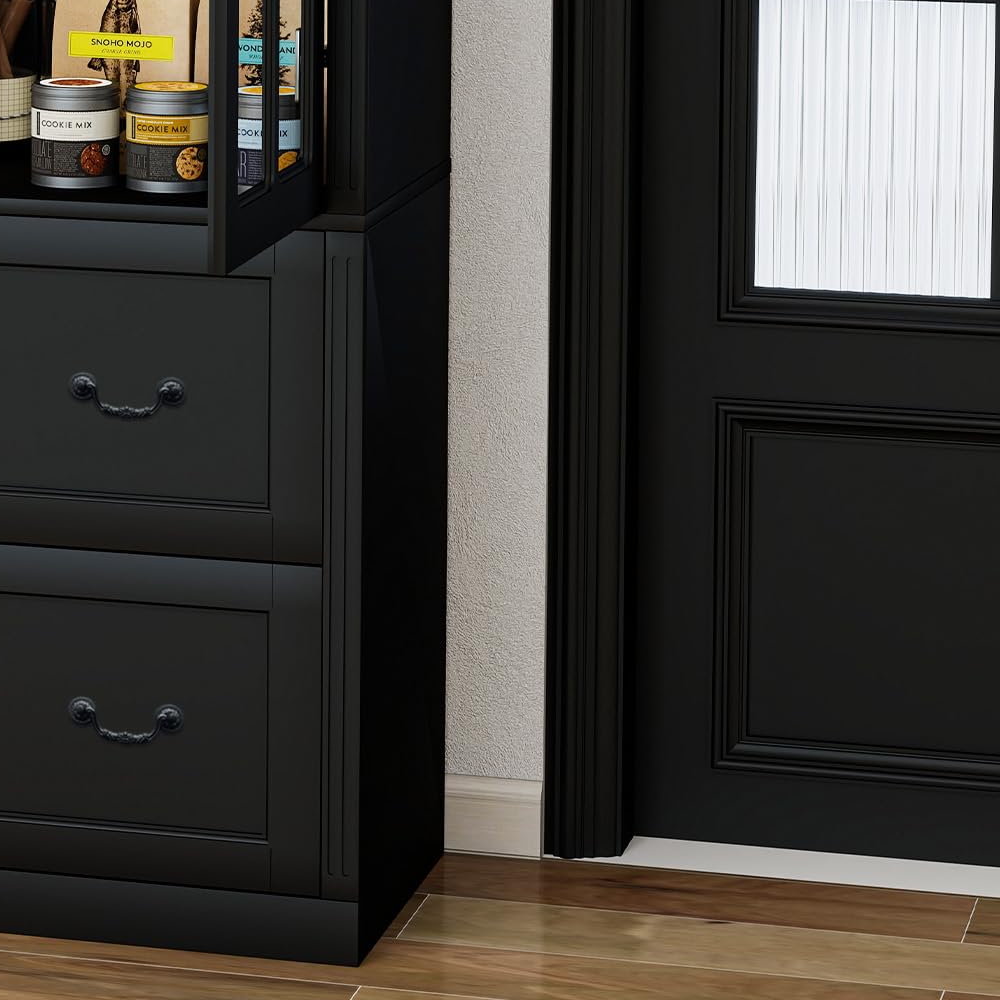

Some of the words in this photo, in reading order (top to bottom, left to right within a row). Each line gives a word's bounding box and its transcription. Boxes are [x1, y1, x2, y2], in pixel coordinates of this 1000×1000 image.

[91, 38, 124, 48] SNOHO
[126, 40, 153, 49] MOJO
[41, 119, 73, 129] COOKIE
[75, 120, 92, 129] MIX
[136, 124, 169, 133] COOKIE
[171, 124, 188, 133] MIX
